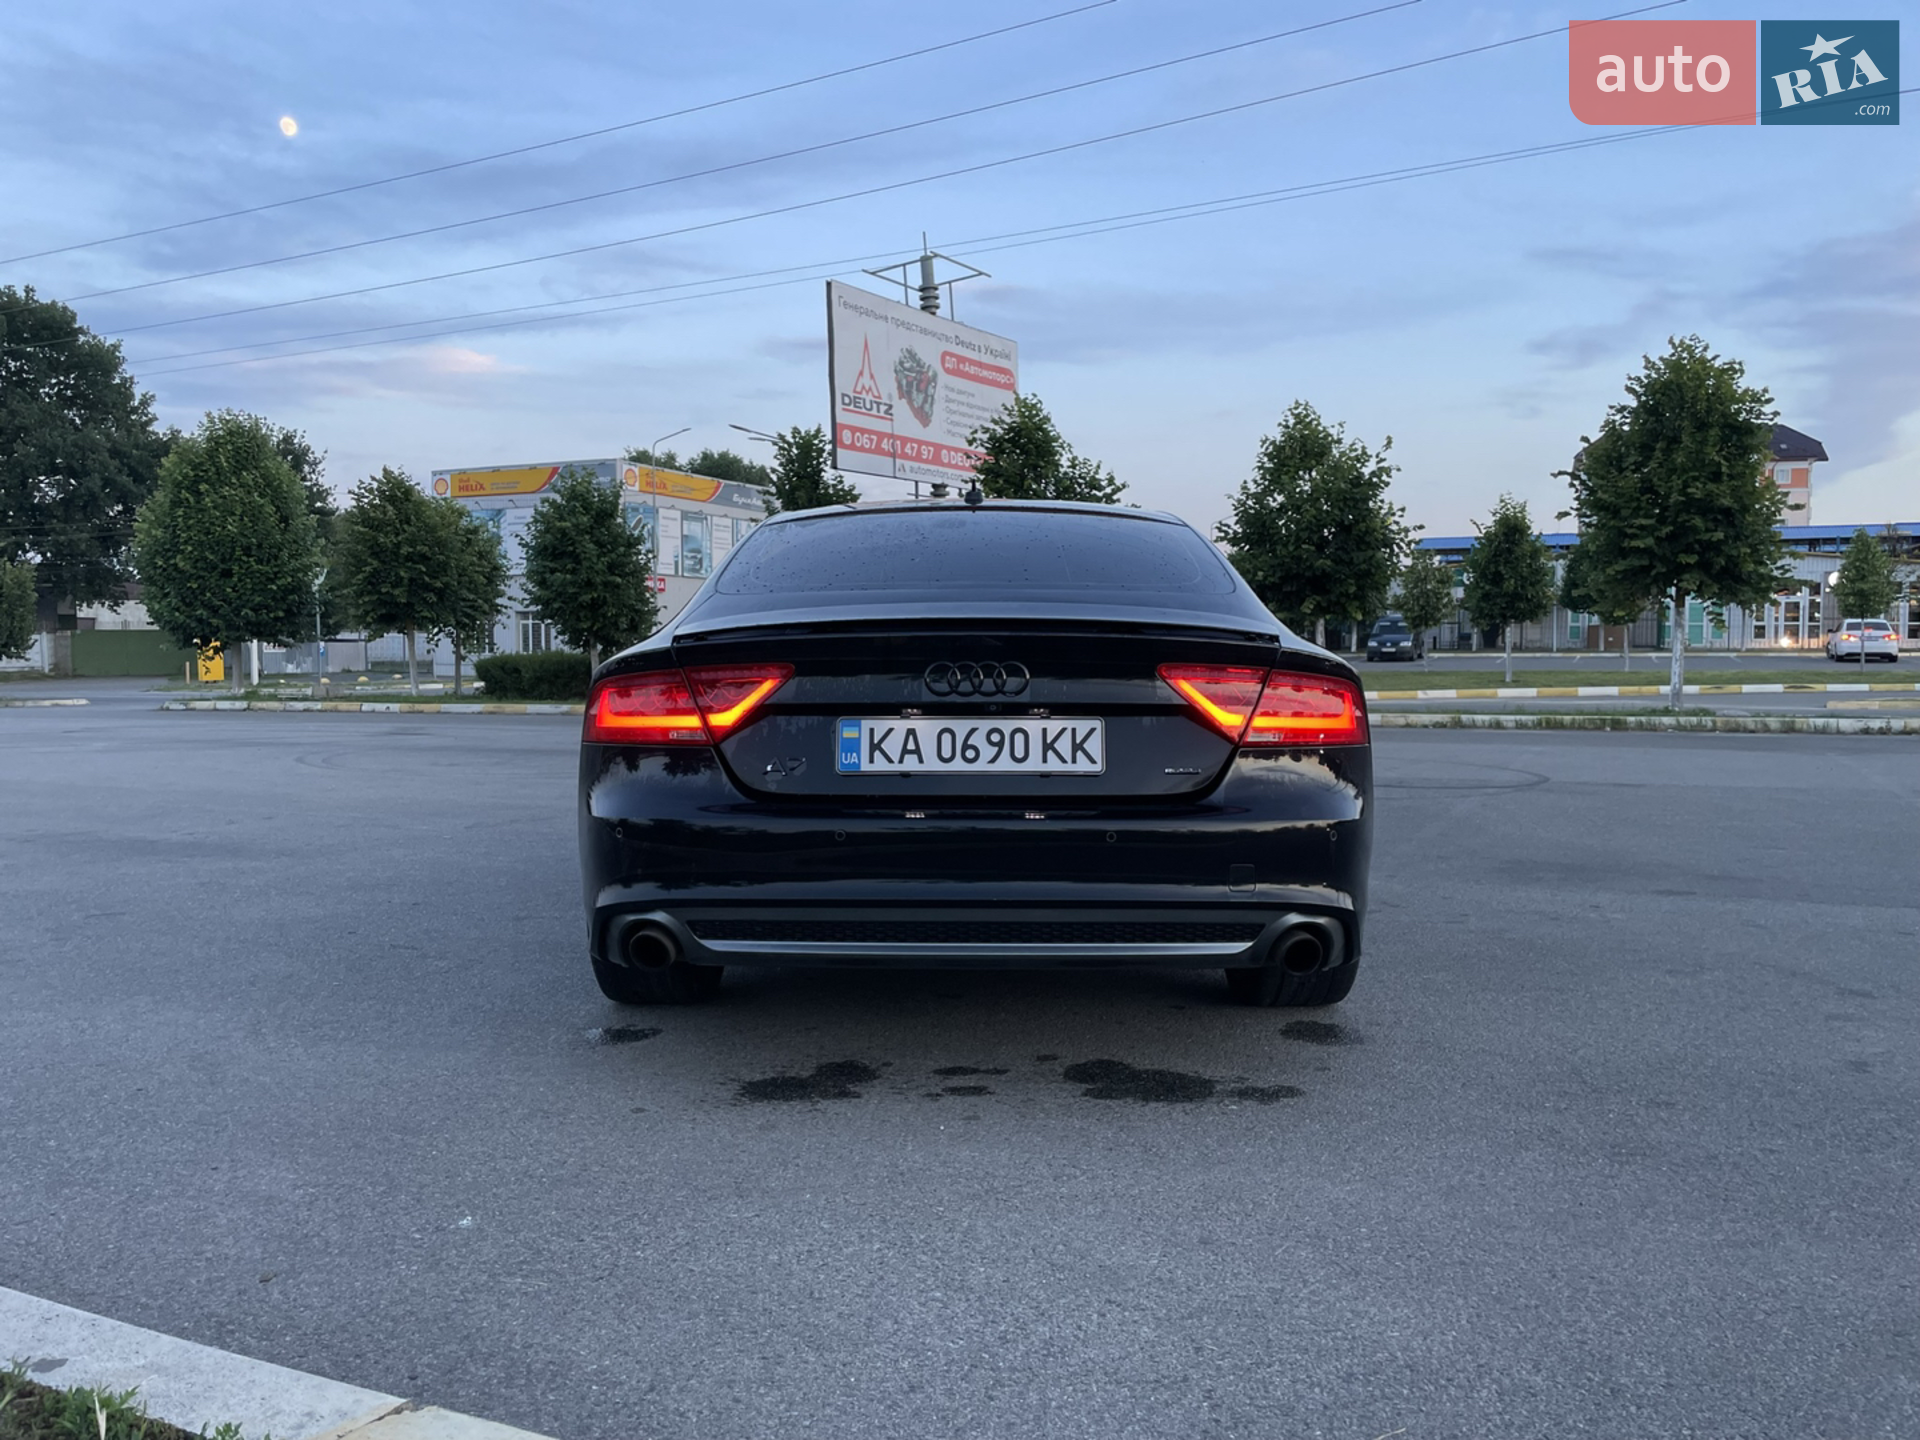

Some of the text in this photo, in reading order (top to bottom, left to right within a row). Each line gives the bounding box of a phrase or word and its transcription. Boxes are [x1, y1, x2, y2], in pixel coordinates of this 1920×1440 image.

[838, 295, 889, 324] Генеральне
[891, 315, 954, 345] представництво
[954, 334, 977, 352] Deutz
[984, 344, 1011, 361] Україні
[841, 392, 894, 416] DEUTZ
[854, 431, 878, 449] 067
[904, 442, 918, 457] 47
[921, 444, 934, 460] 97
[458, 482, 486, 493] HELIX
[842, 727, 1098, 765] UA KA 0690 KK
